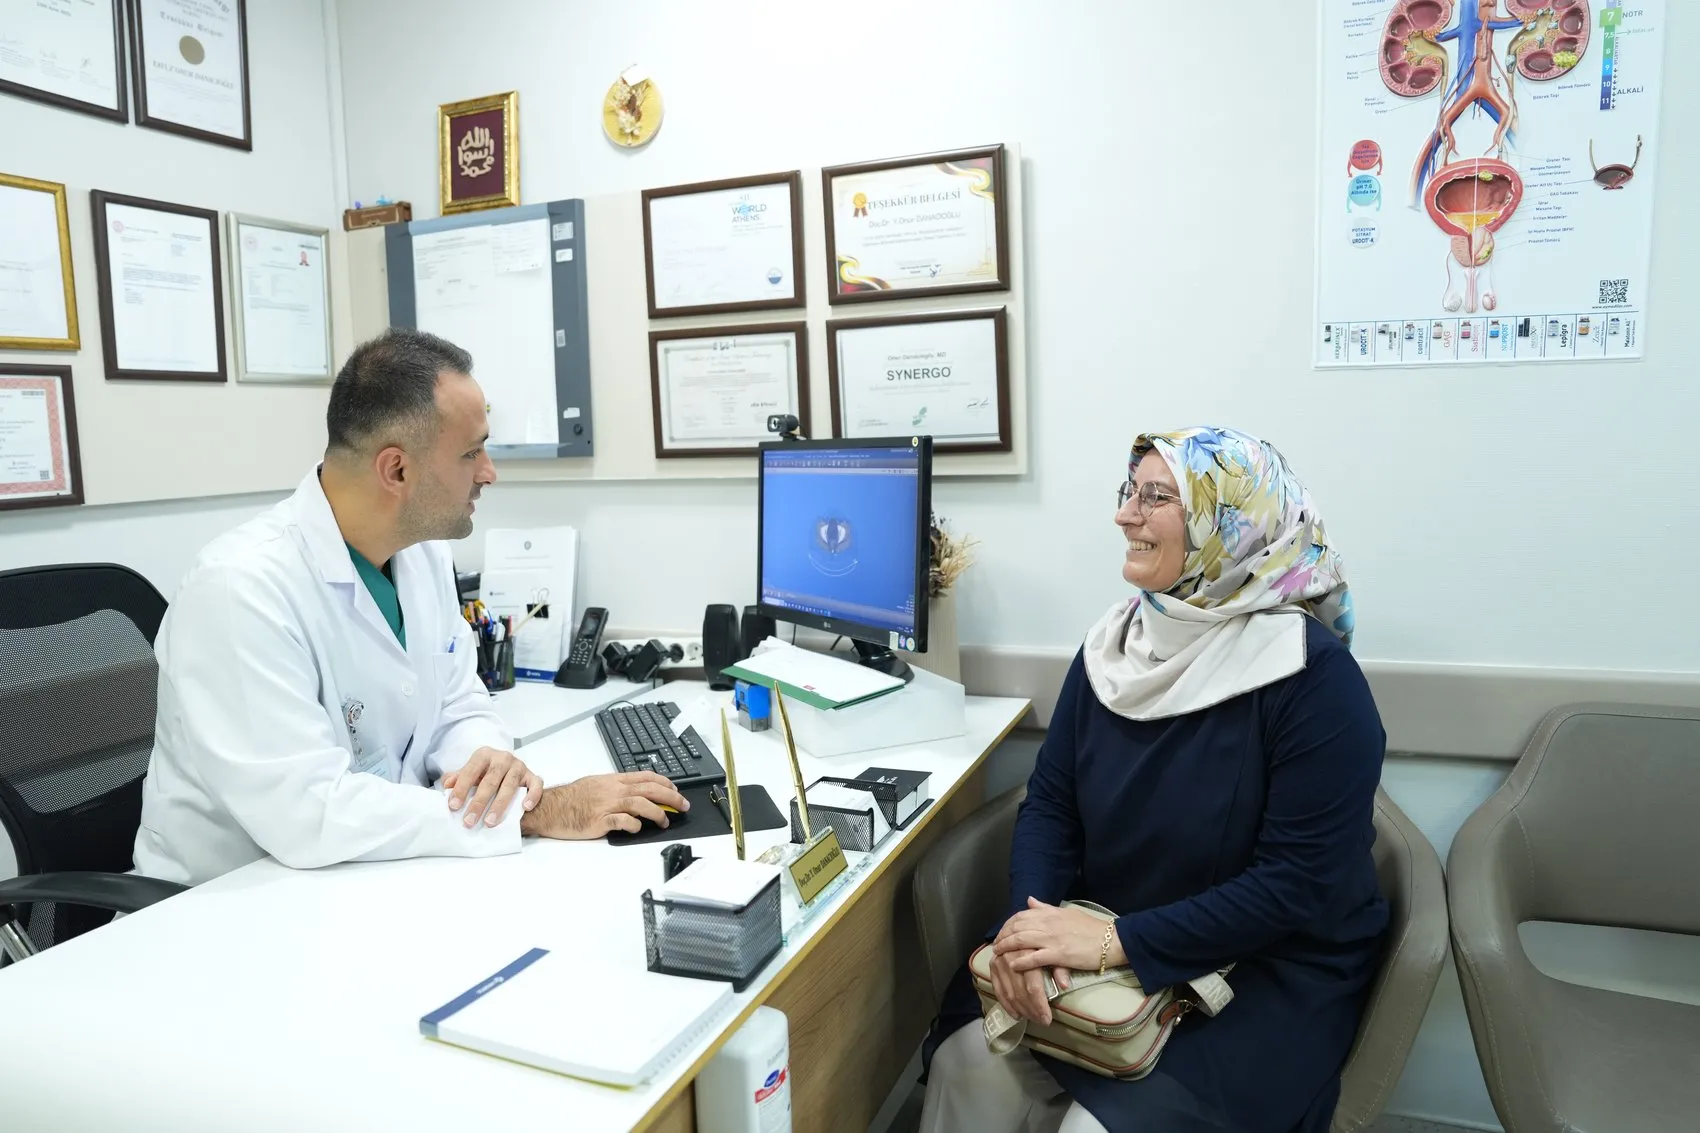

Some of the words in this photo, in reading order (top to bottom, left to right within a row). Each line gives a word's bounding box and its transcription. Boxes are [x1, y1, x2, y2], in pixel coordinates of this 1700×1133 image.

[1607, 12, 1615, 22] 7
[1617, 86, 1644, 94] ALKALİ
[920, 188, 961, 204] BELGESİ
[732, 203, 767, 215] WORLD
[887, 367, 951, 381] SYNERGO
